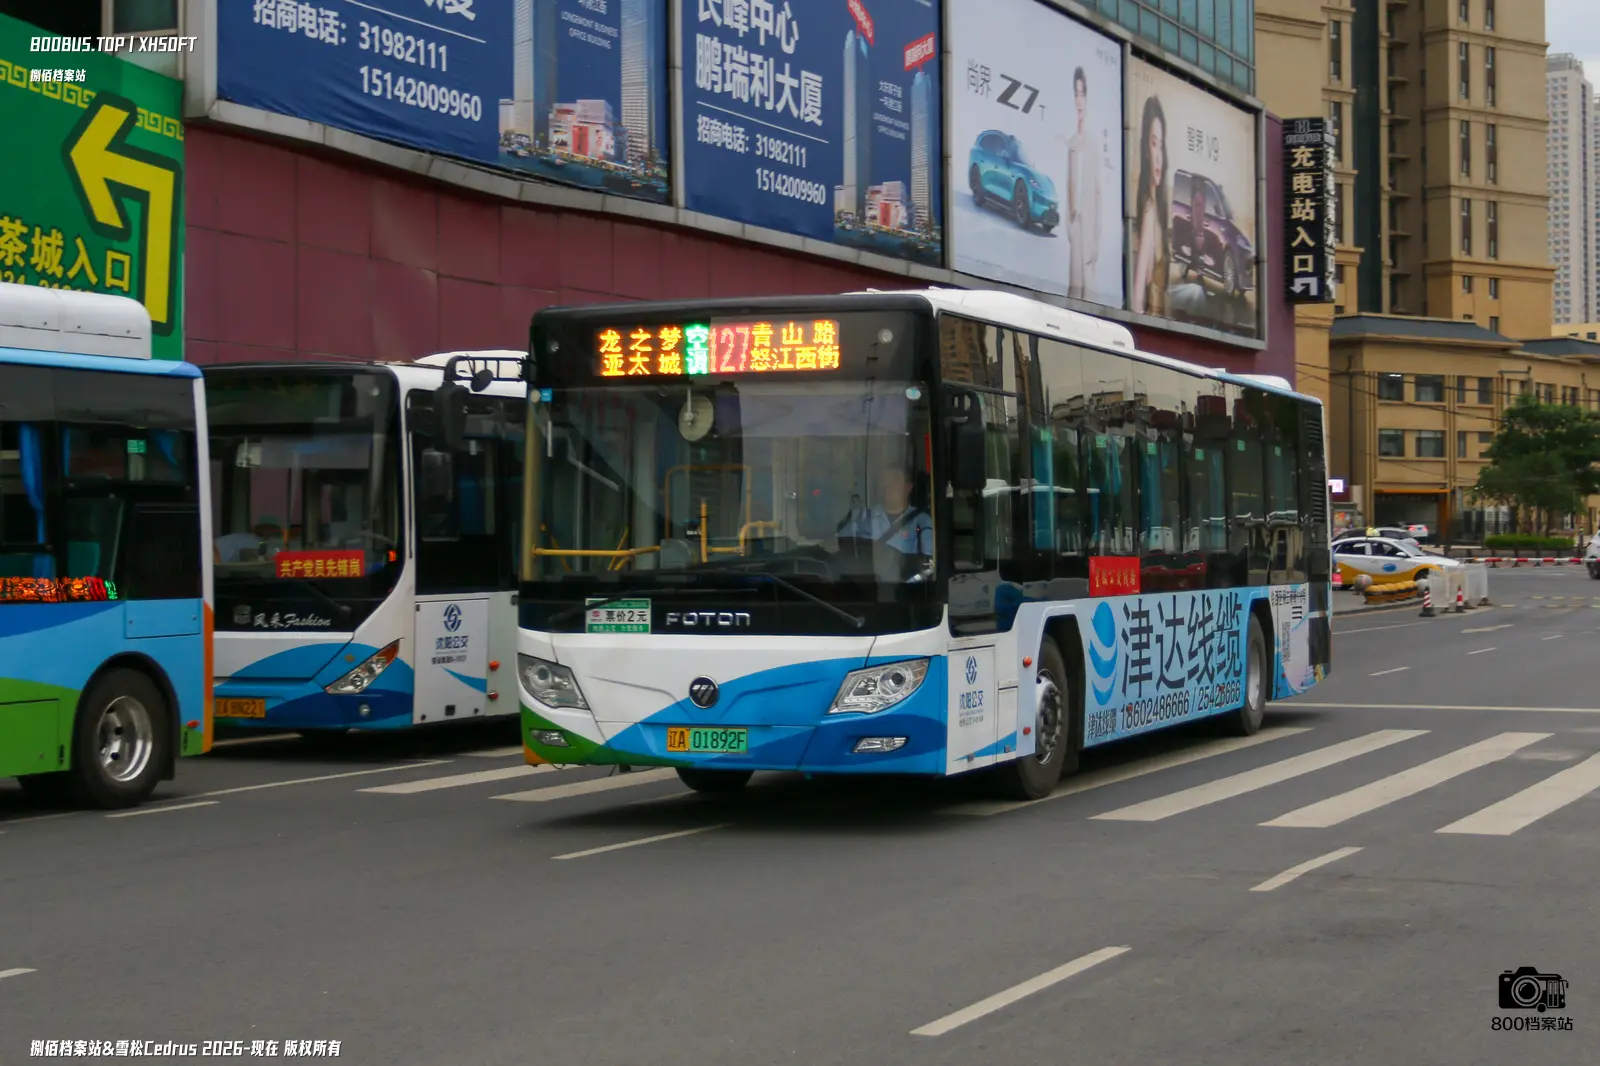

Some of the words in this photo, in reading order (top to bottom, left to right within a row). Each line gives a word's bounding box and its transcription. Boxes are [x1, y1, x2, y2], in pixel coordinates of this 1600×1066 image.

[358, 21, 447, 72] 31982111
[359, 65, 482, 122] 15142009960
[695, 33, 823, 127] 鹏瑞利大厦
[755, 134, 806, 168] 31982111
[756, 167, 826, 206] 15142009960
[1291, 145, 1316, 273] 充电站入口
[0, 216, 131, 292] 茶城入口
[600, 327, 683, 354] 龙之梦
[685, 323, 710, 375] 空调
[709, 326, 750, 373] 127
[751, 319, 836, 347] 青山路
[601, 351, 683, 376] 亚太城
[750, 344, 840, 371] 怒江西街
[281, 558, 361, 577] 共产党员先锋岗
[284, 613, 332, 628] Fashion
[605, 610, 647, 623] 票价2元
[666, 612, 750, 626] FOTON
[1121, 592, 1243, 698] 津达线缆
